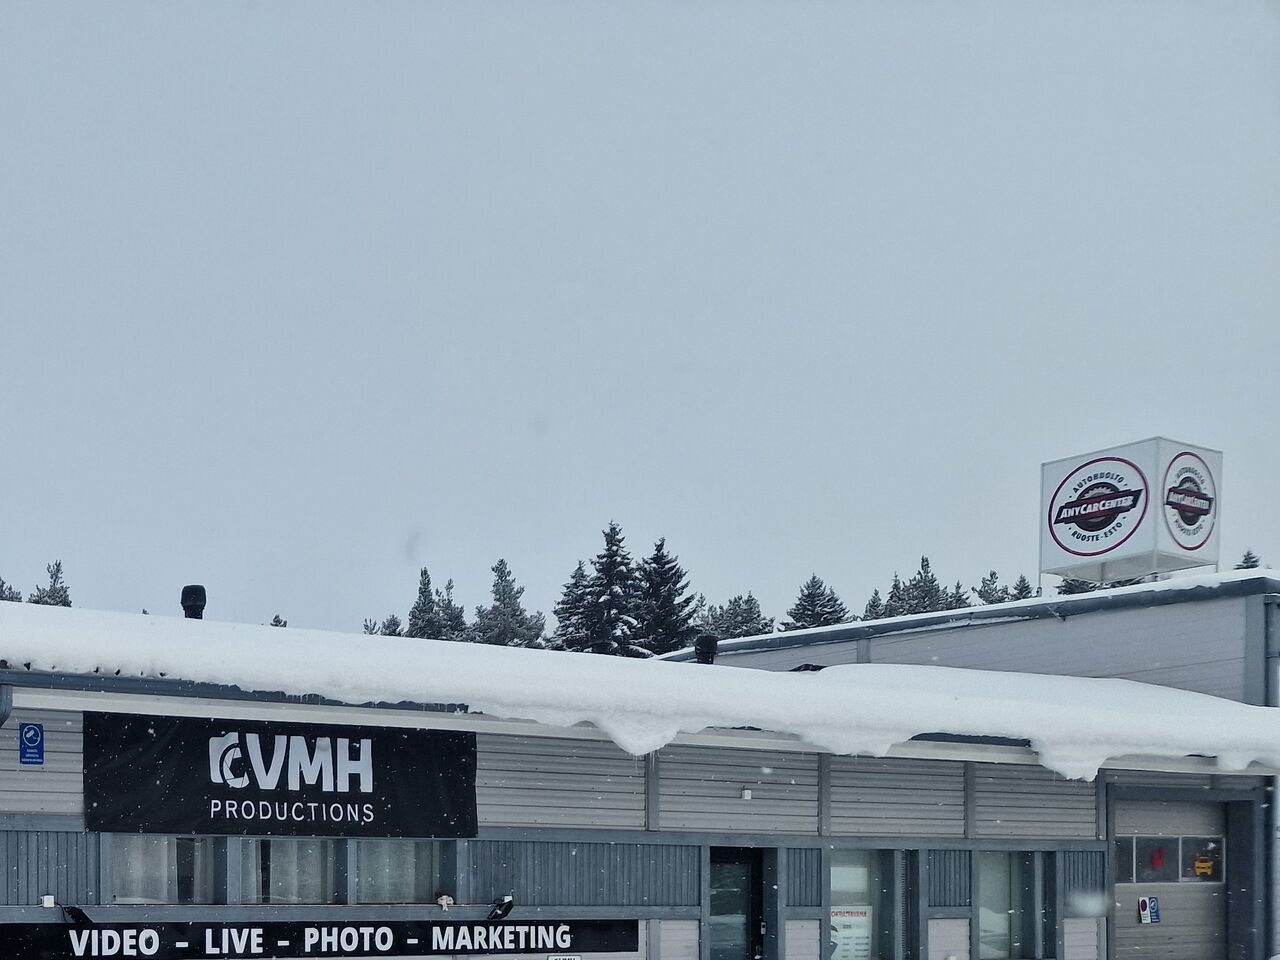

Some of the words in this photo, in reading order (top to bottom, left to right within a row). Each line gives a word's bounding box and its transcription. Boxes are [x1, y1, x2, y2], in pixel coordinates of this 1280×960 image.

[1072, 472, 1125, 494] AUTOHUOLTO
[1071, 522, 1123, 542] RUOSTE-ESTO
[210, 800, 375, 822] PRODUCTIONS
[69, 928, 160, 956] VIDEO
[205, 928, 263, 954] LIVE
[304, 926, 393, 953] PHOTO
[432, 925, 571, 950] MARKETING
